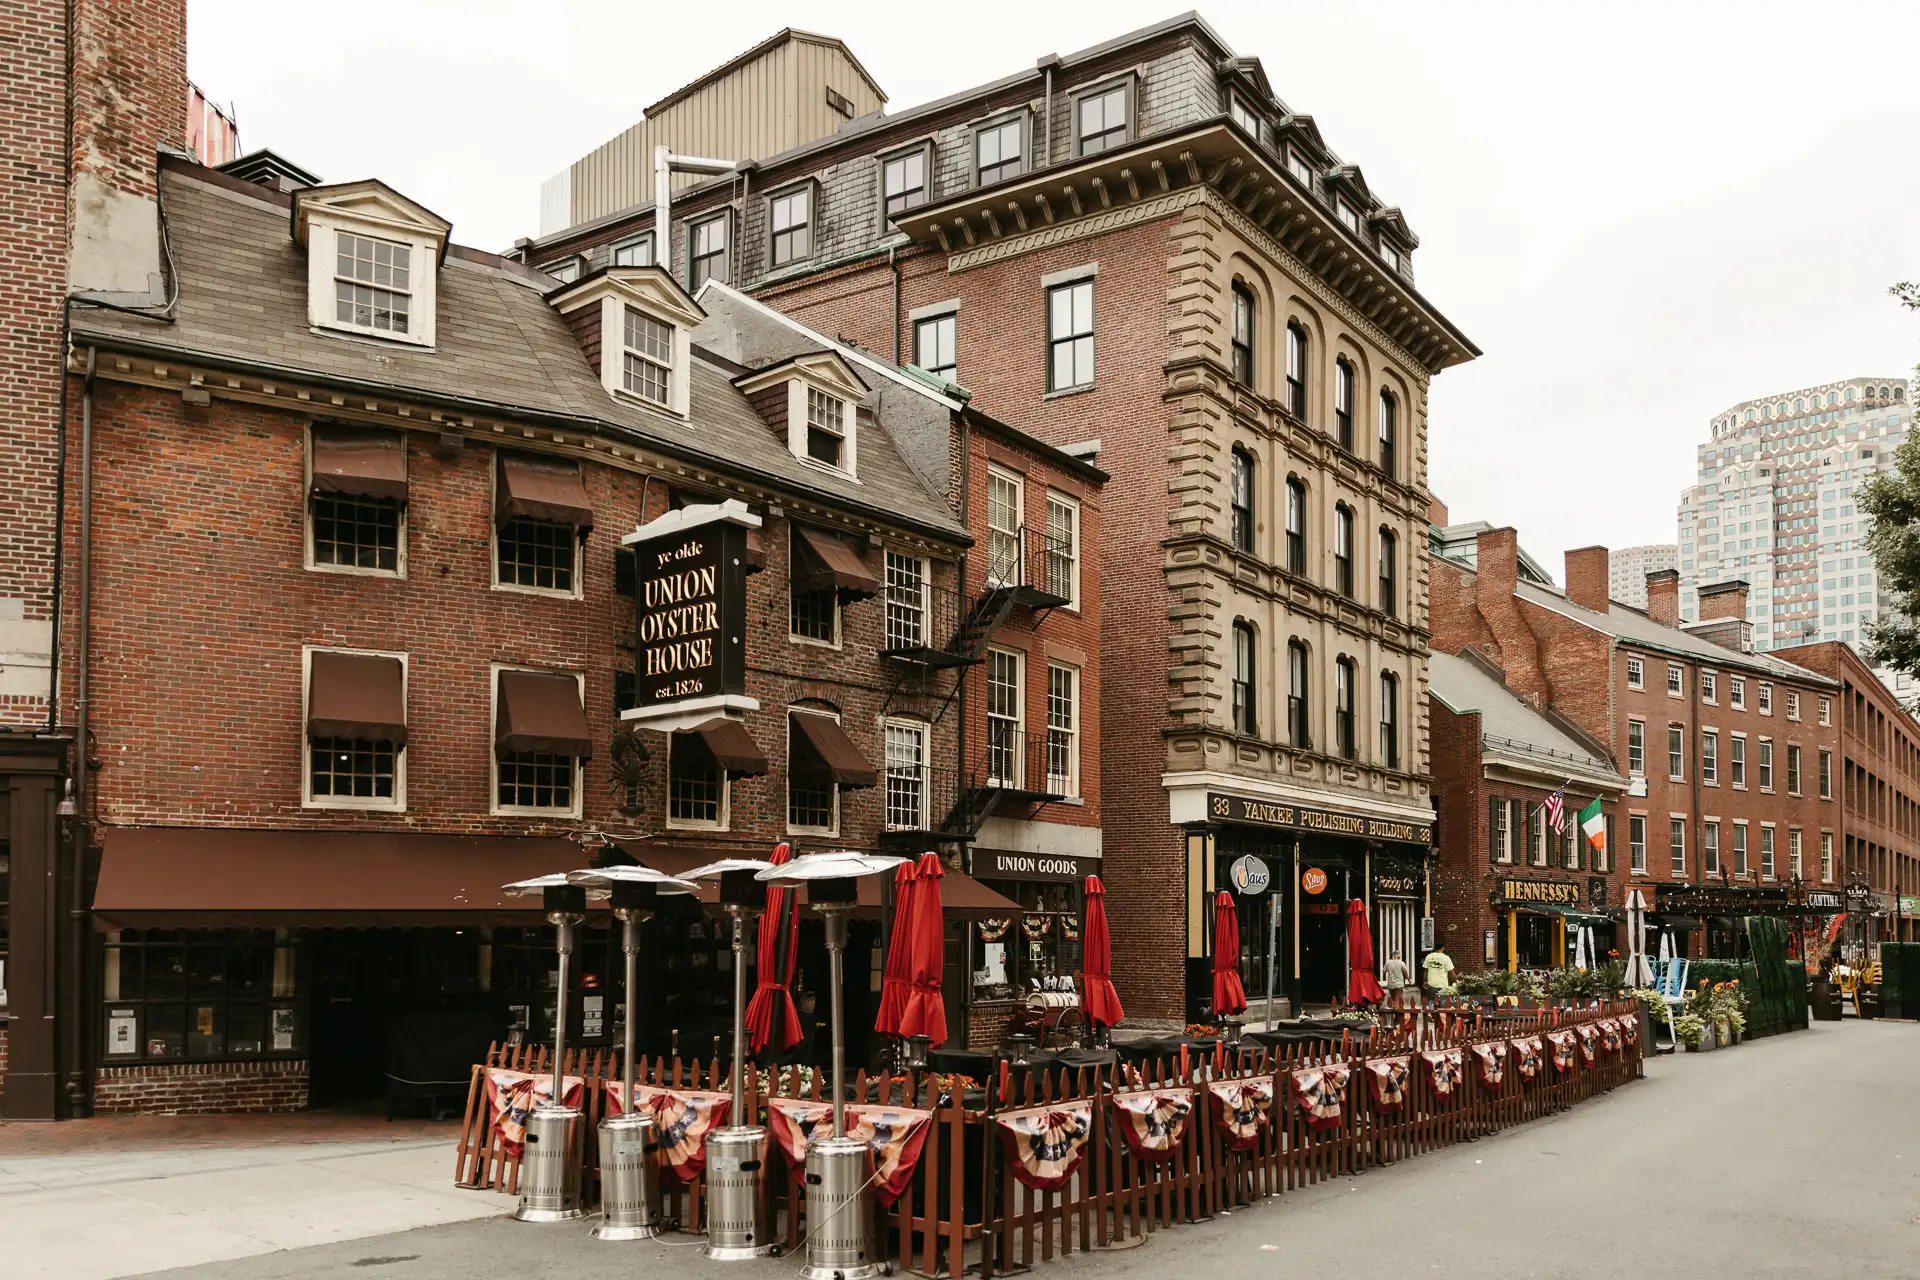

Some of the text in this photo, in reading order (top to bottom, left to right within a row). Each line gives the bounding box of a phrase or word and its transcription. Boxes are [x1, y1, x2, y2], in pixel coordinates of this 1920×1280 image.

[657, 541, 703, 570] ye olde
[644, 565, 717, 609] UNION
[640, 601, 720, 644] OYSTER
[645, 638, 713, 676] HOUSE
[674, 678, 703, 697] 1826
[1213, 797, 1431, 842] 33 YANKEE PUBLISHING BUILDING 33
[997, 855, 1077, 875] UNION GOODS
[1236, 854, 1267, 889] Saus
[1504, 880, 1579, 902] HENNESSY'S
